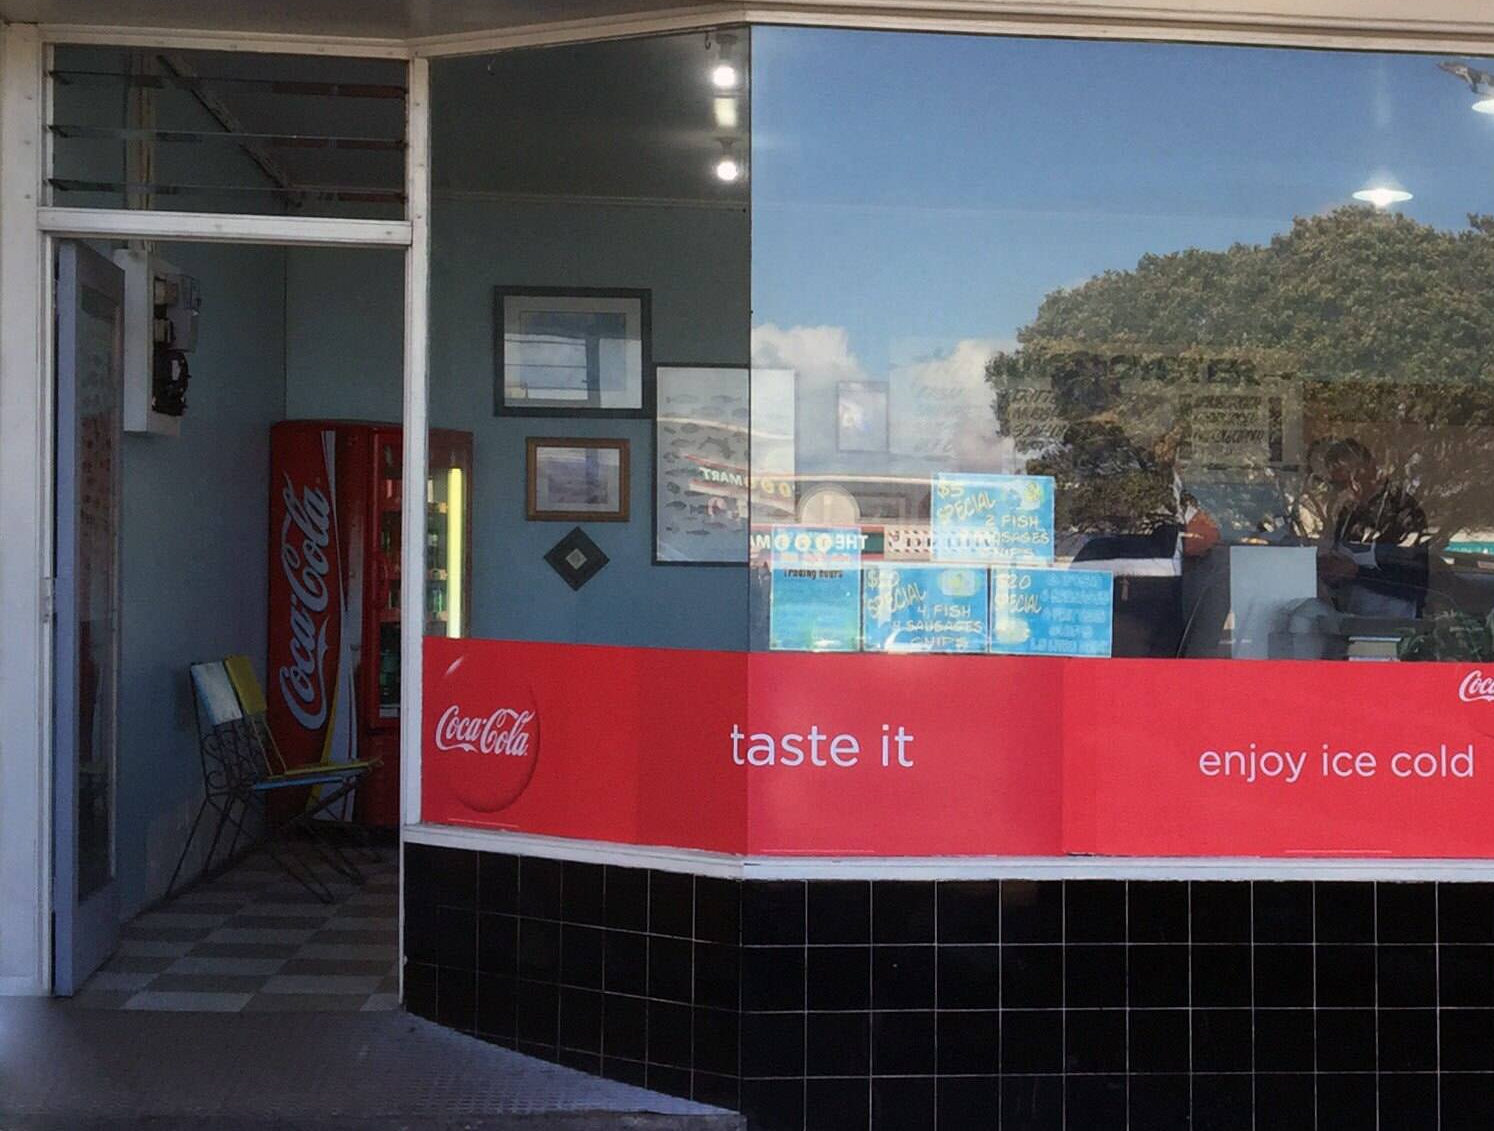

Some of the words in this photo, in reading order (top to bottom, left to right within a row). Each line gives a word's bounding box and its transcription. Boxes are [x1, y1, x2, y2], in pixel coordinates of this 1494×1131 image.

[1001, 514, 1039, 528] FISH
[279, 469, 331, 730] Coca-Cola
[933, 604, 972, 619] FISH
[906, 619, 984, 635] SAUSAGES
[435, 705, 535, 757] Coca-Cola
[731, 724, 859, 767] taste
[882, 725, 914, 767] it
[1199, 744, 1307, 783] enjoy
[1322, 744, 1377, 777] ice
[1391, 744, 1474, 778] cold
